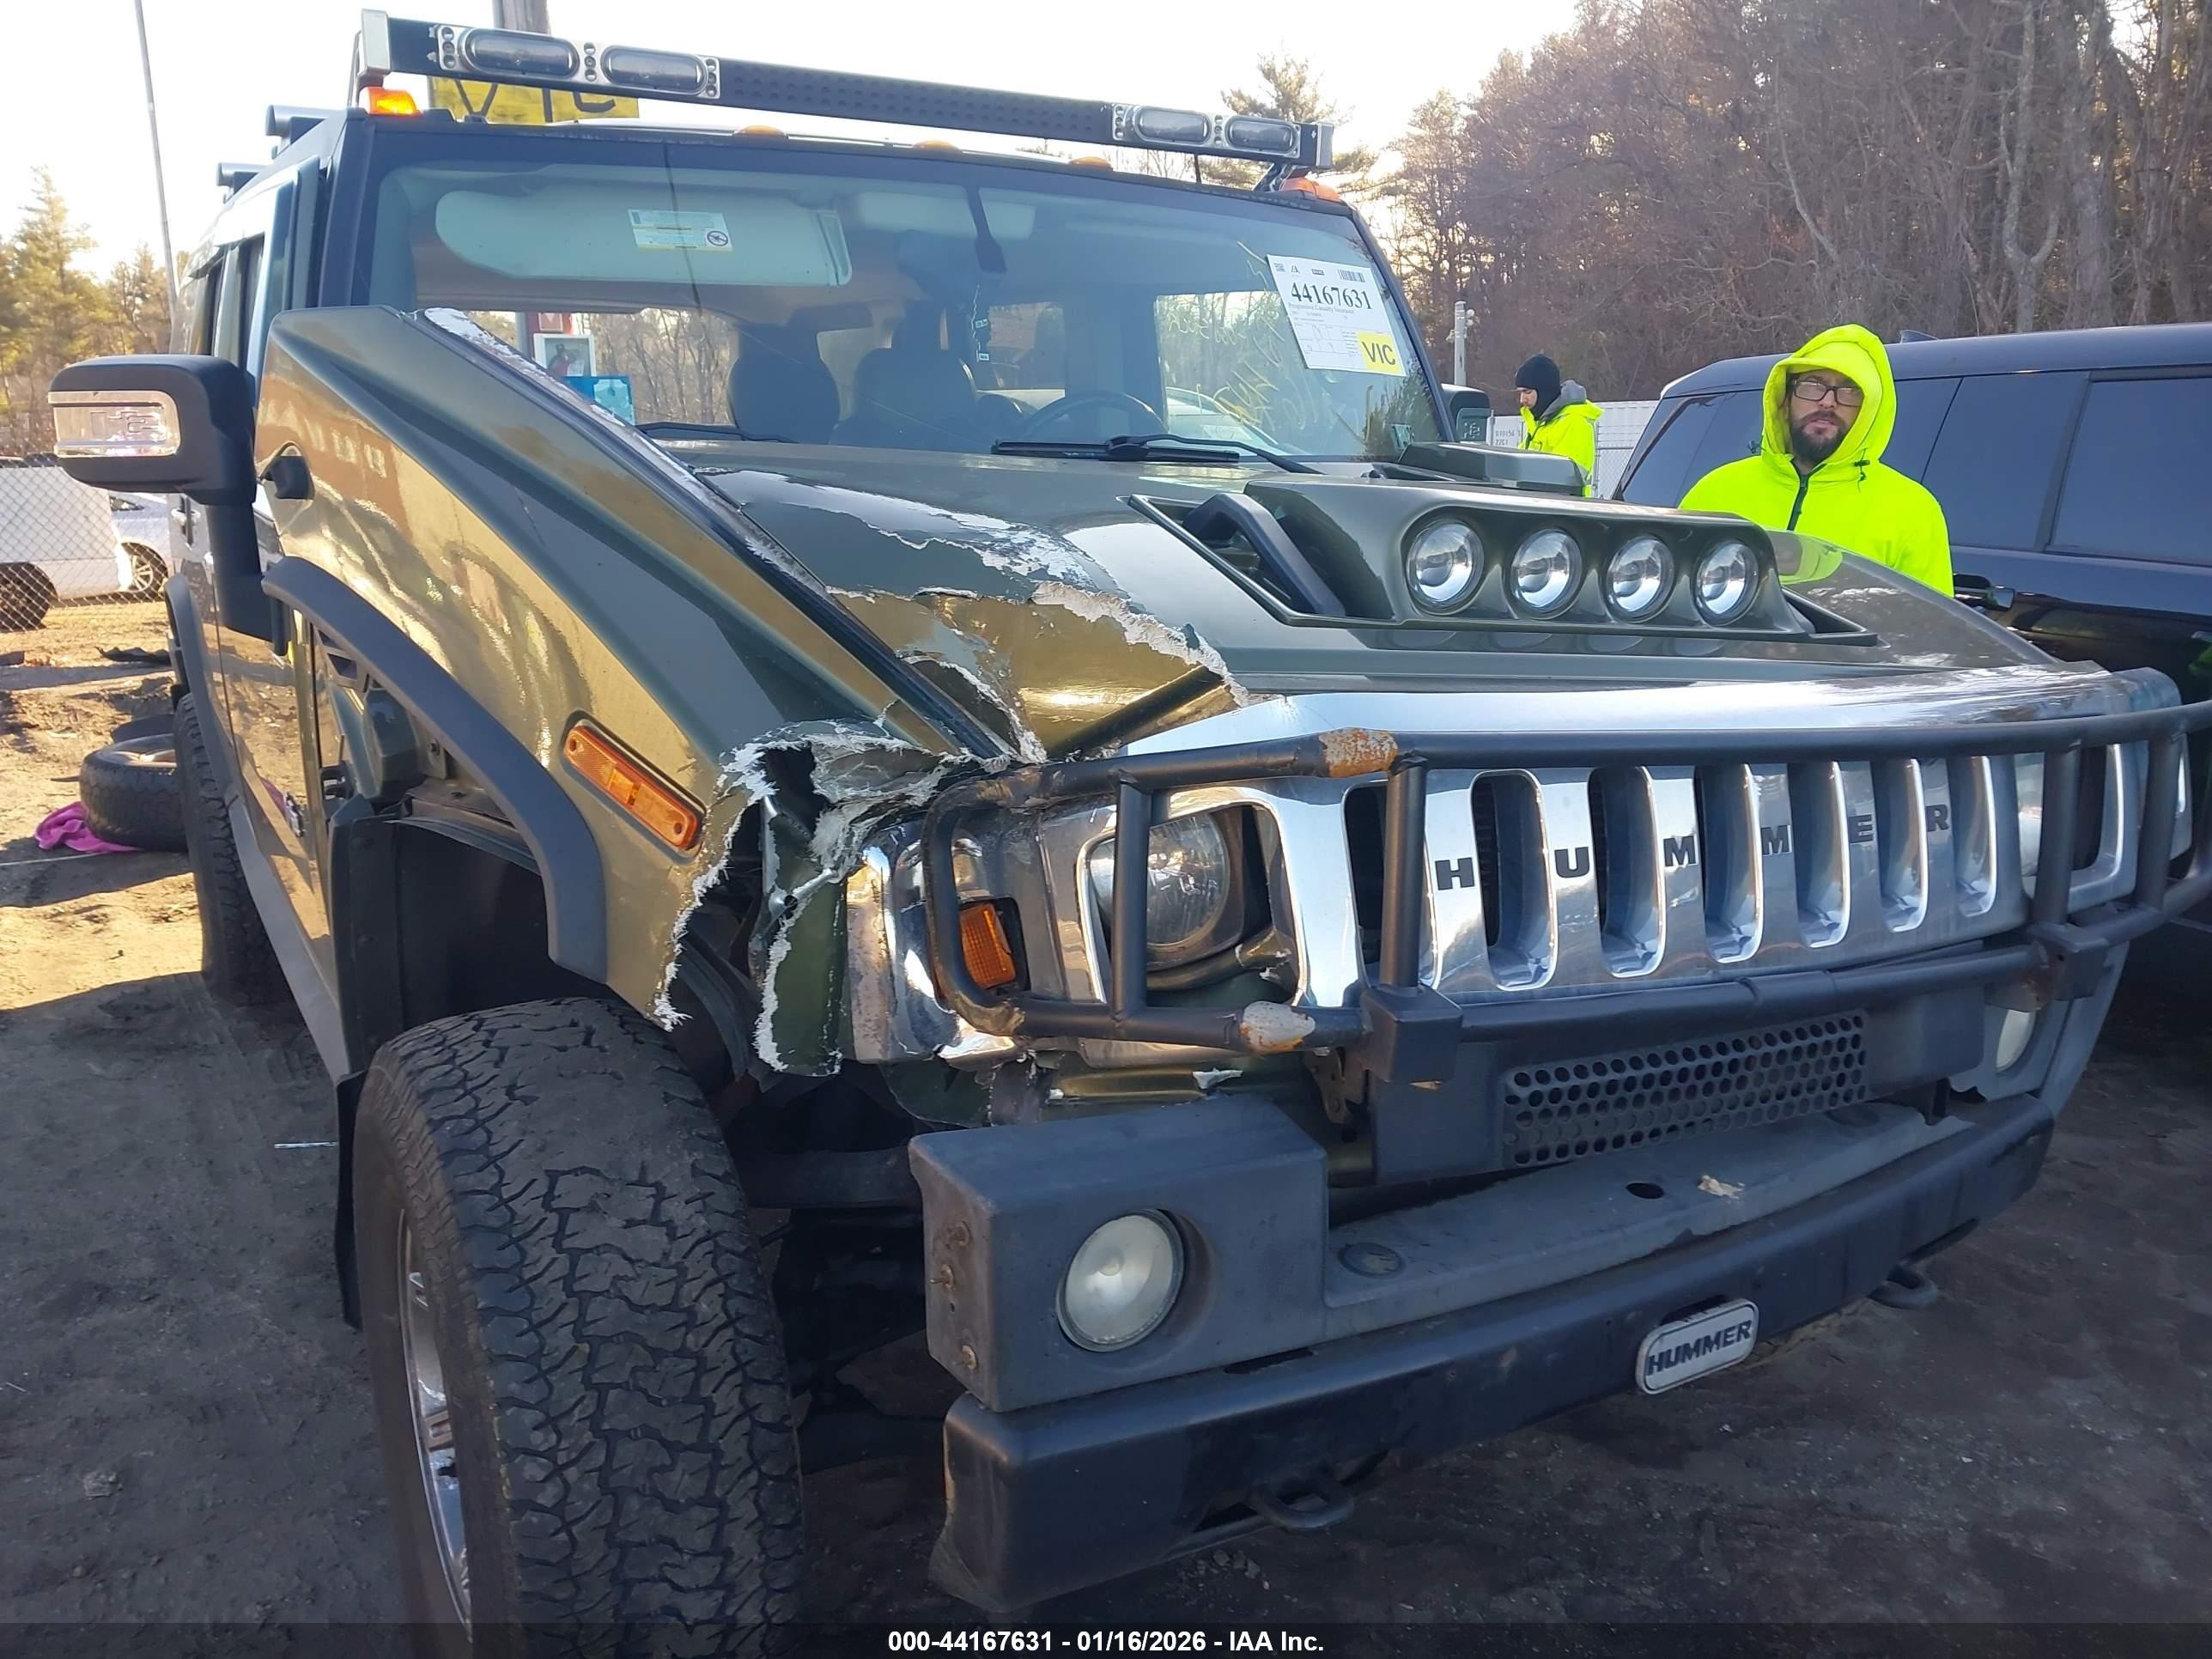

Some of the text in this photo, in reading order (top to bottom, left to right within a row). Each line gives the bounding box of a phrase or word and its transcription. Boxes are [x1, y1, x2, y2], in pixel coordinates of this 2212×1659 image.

[1291, 281, 1373, 310] 44167631
[1361, 341, 1396, 366] VIC
[1646, 1320, 1752, 1376] HUMMER
